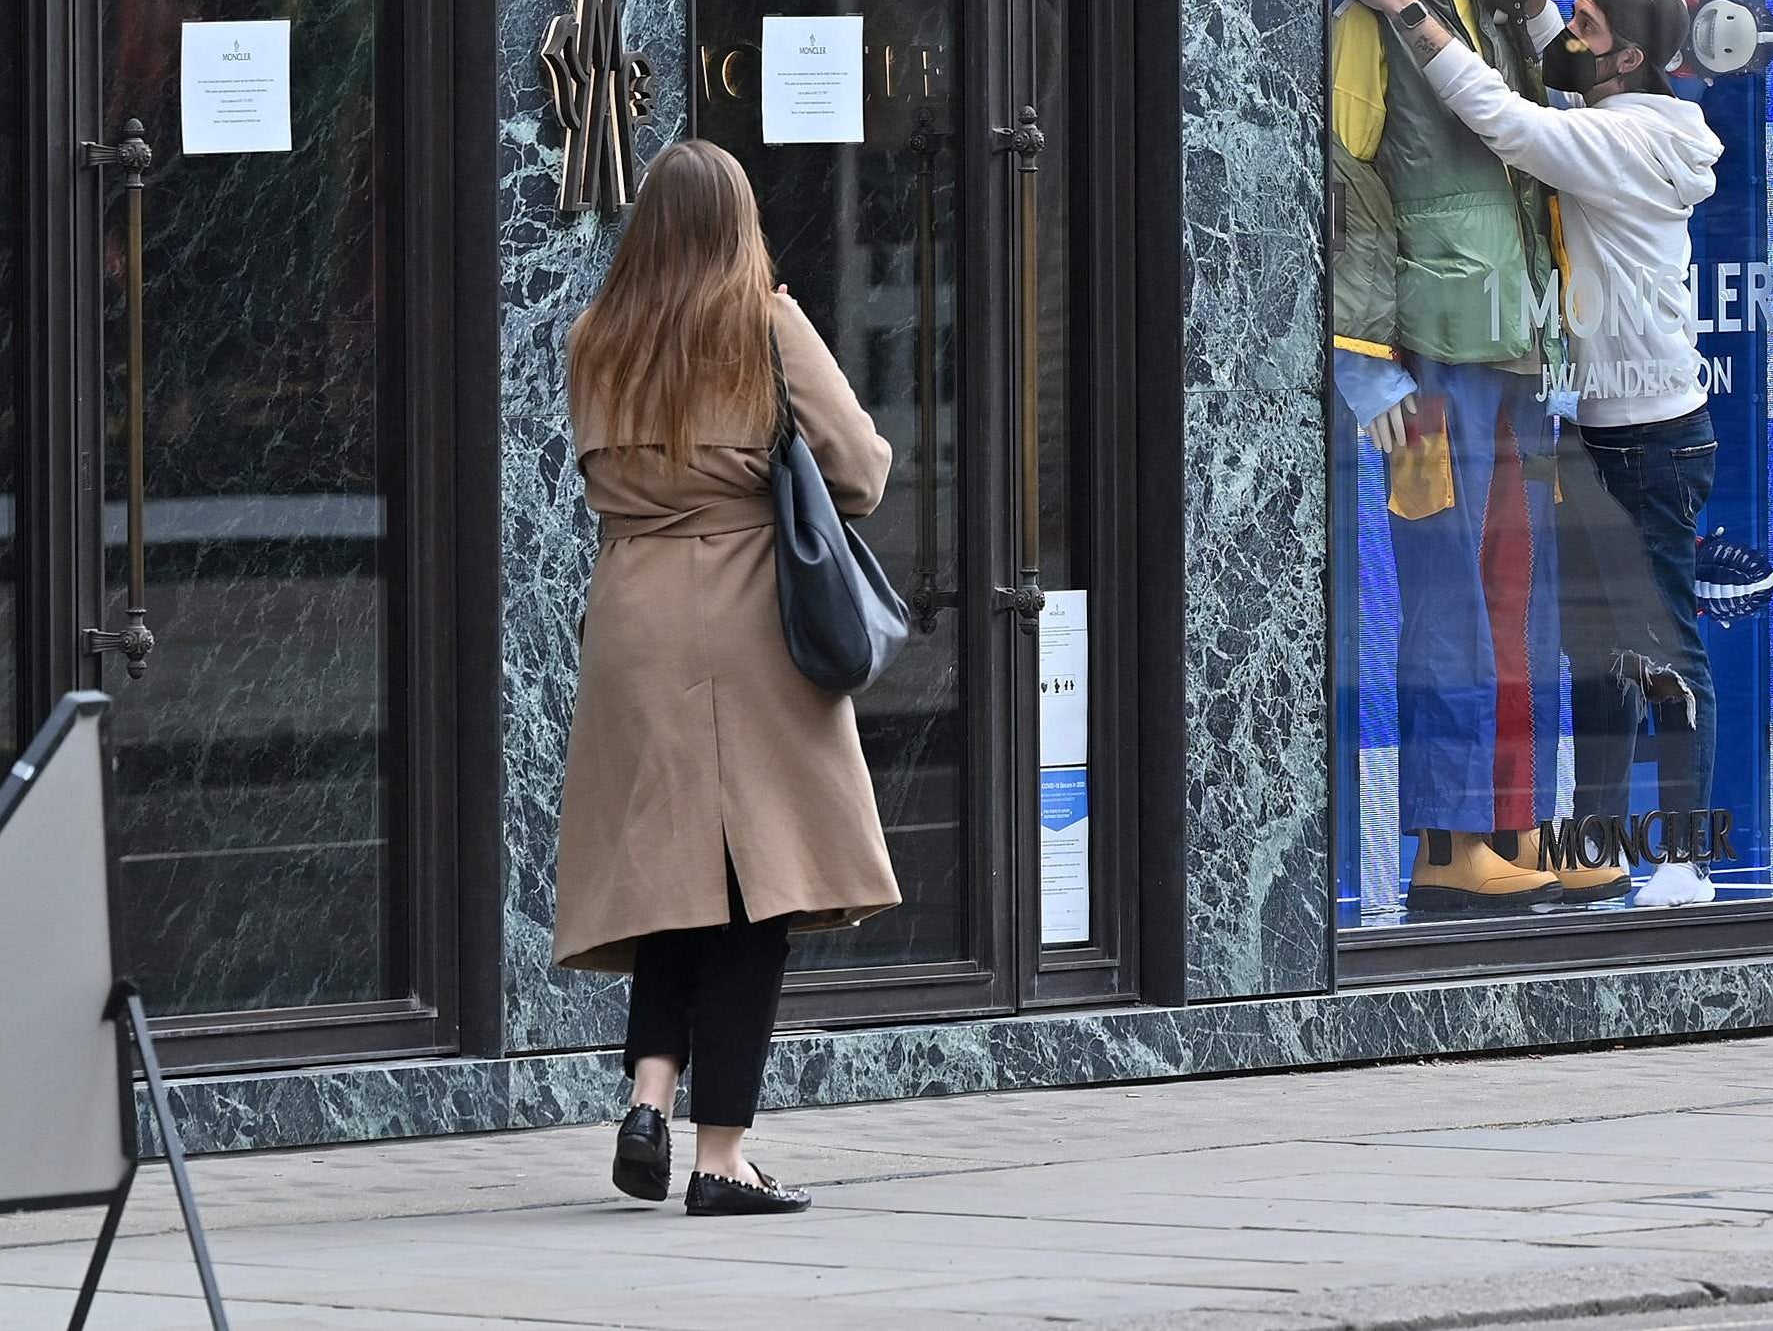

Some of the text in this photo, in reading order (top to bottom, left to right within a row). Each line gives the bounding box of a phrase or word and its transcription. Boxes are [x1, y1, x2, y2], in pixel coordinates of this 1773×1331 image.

[1483, 268, 1501, 342] 1
[1535, 356, 1733, 403] JW ANDERSON
[1536, 808, 1738, 872] MONCLER
